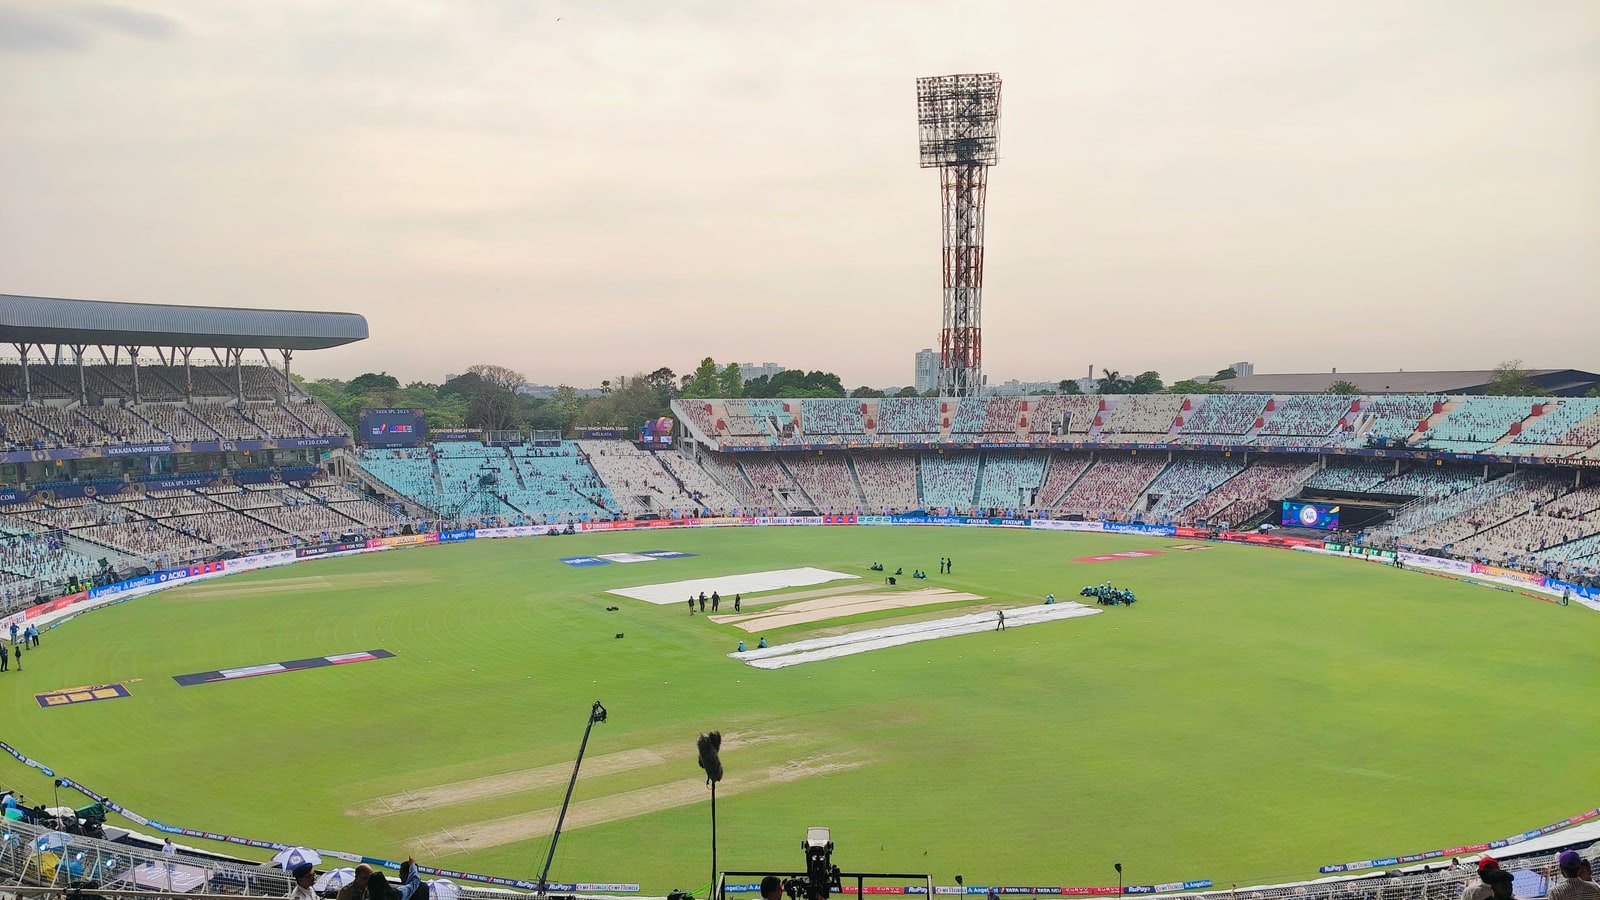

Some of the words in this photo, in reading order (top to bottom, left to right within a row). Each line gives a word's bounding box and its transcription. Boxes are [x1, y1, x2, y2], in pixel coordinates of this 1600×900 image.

[168, 571, 186, 580] ACKO
[130, 578, 155, 589] AngelOne
[96, 585, 121, 598] AngelOne
[1325, 864, 1341, 872] RuPay
[517, 881, 533, 889] RuPay
